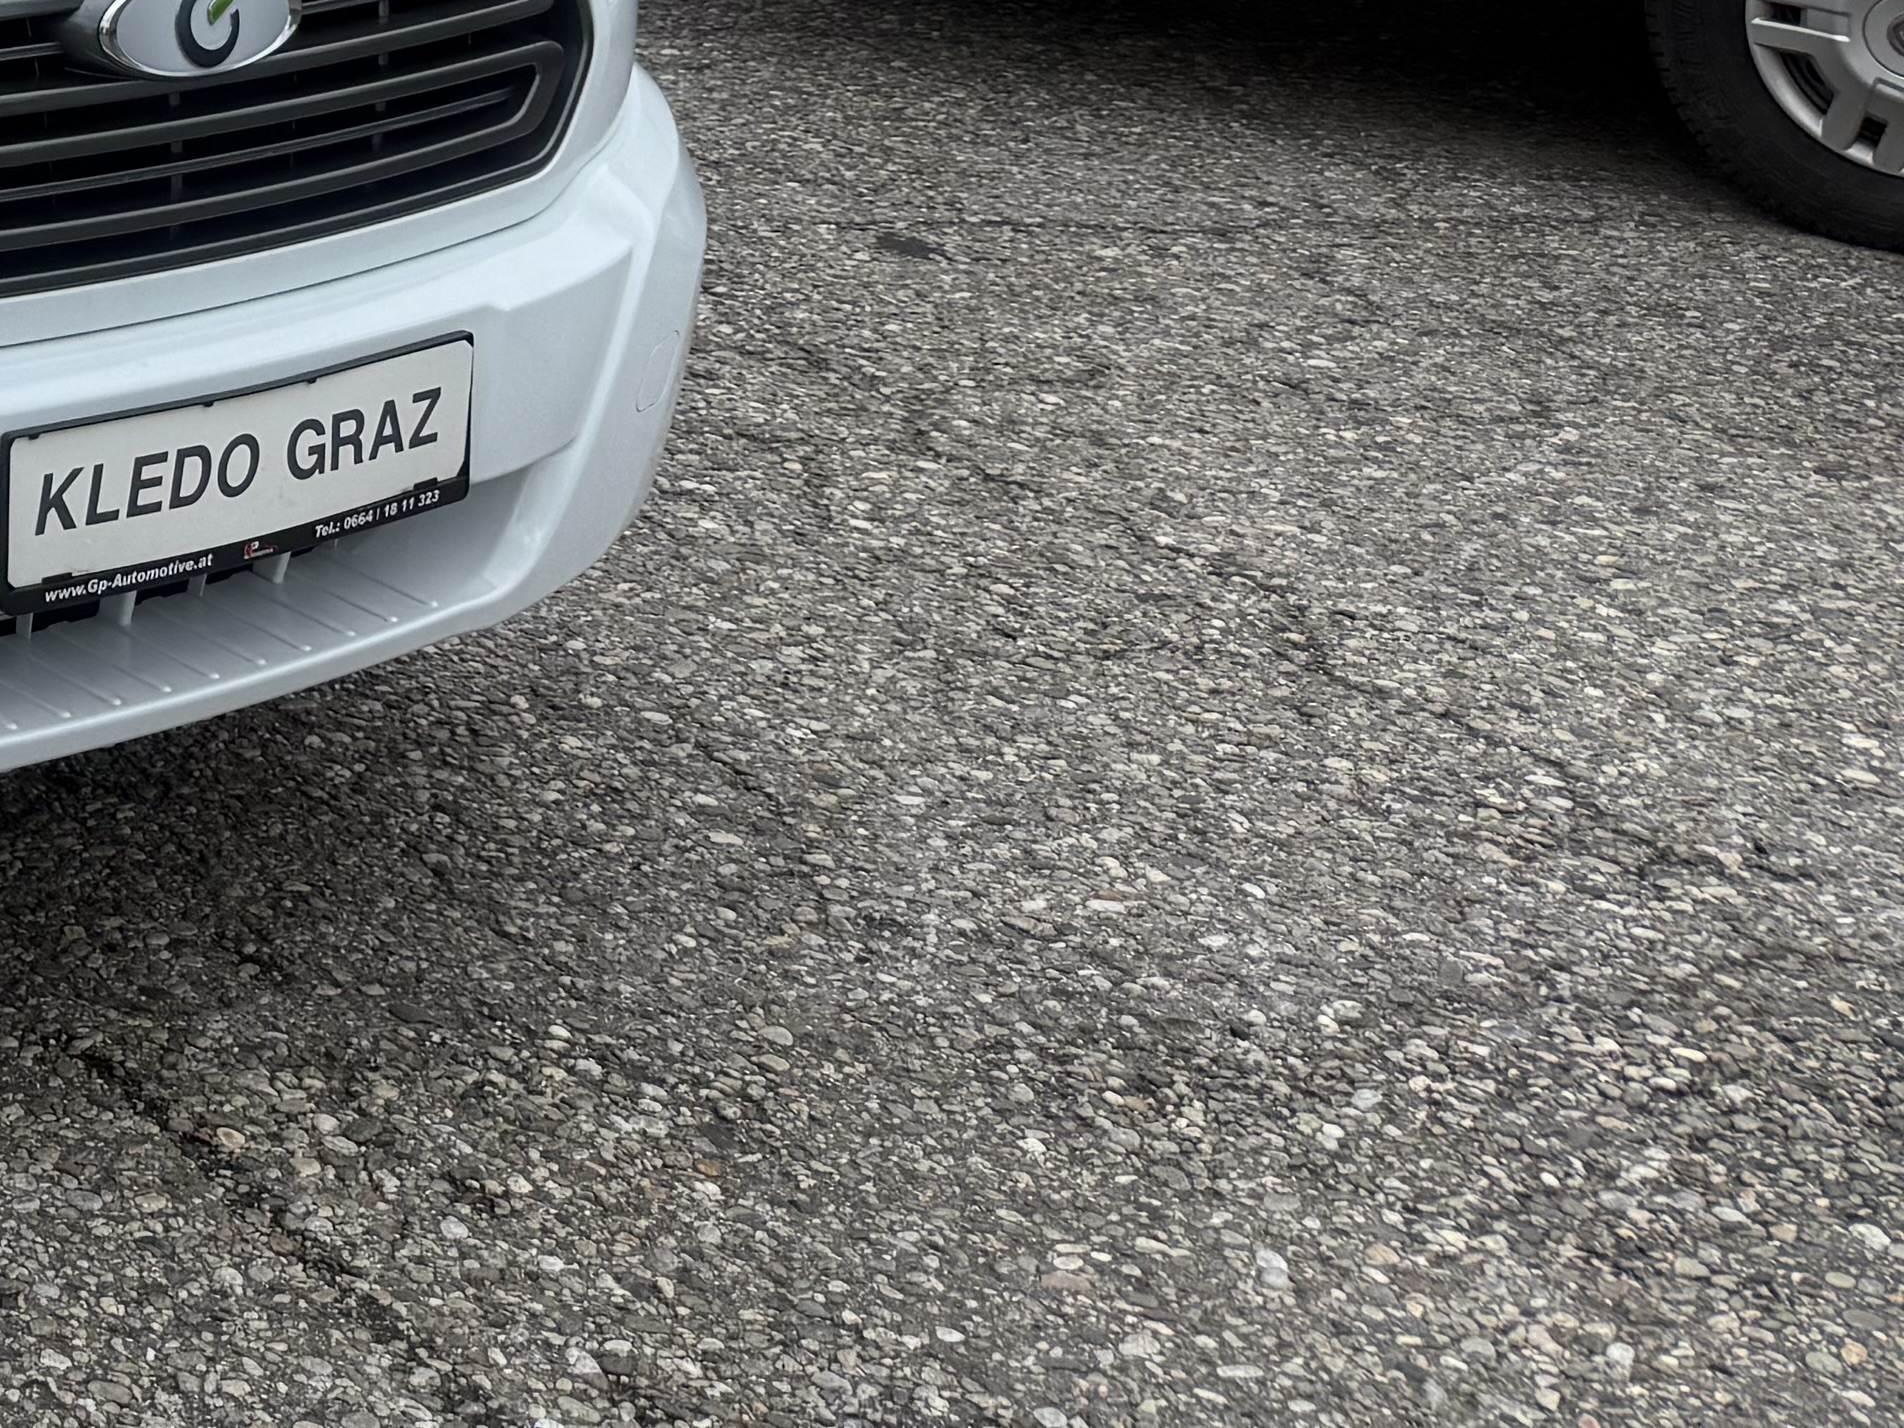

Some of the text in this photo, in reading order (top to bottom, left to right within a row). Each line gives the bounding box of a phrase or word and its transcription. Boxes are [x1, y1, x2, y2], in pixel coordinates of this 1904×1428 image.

[34, 386, 443, 537] KLEDO GRAZ
[315, 521, 341, 538] Tel.:
[343, 509, 373, 530] 0664
[417, 489, 440, 507] 323
[44, 552, 213, 603] www.Gp-Automotive.at
